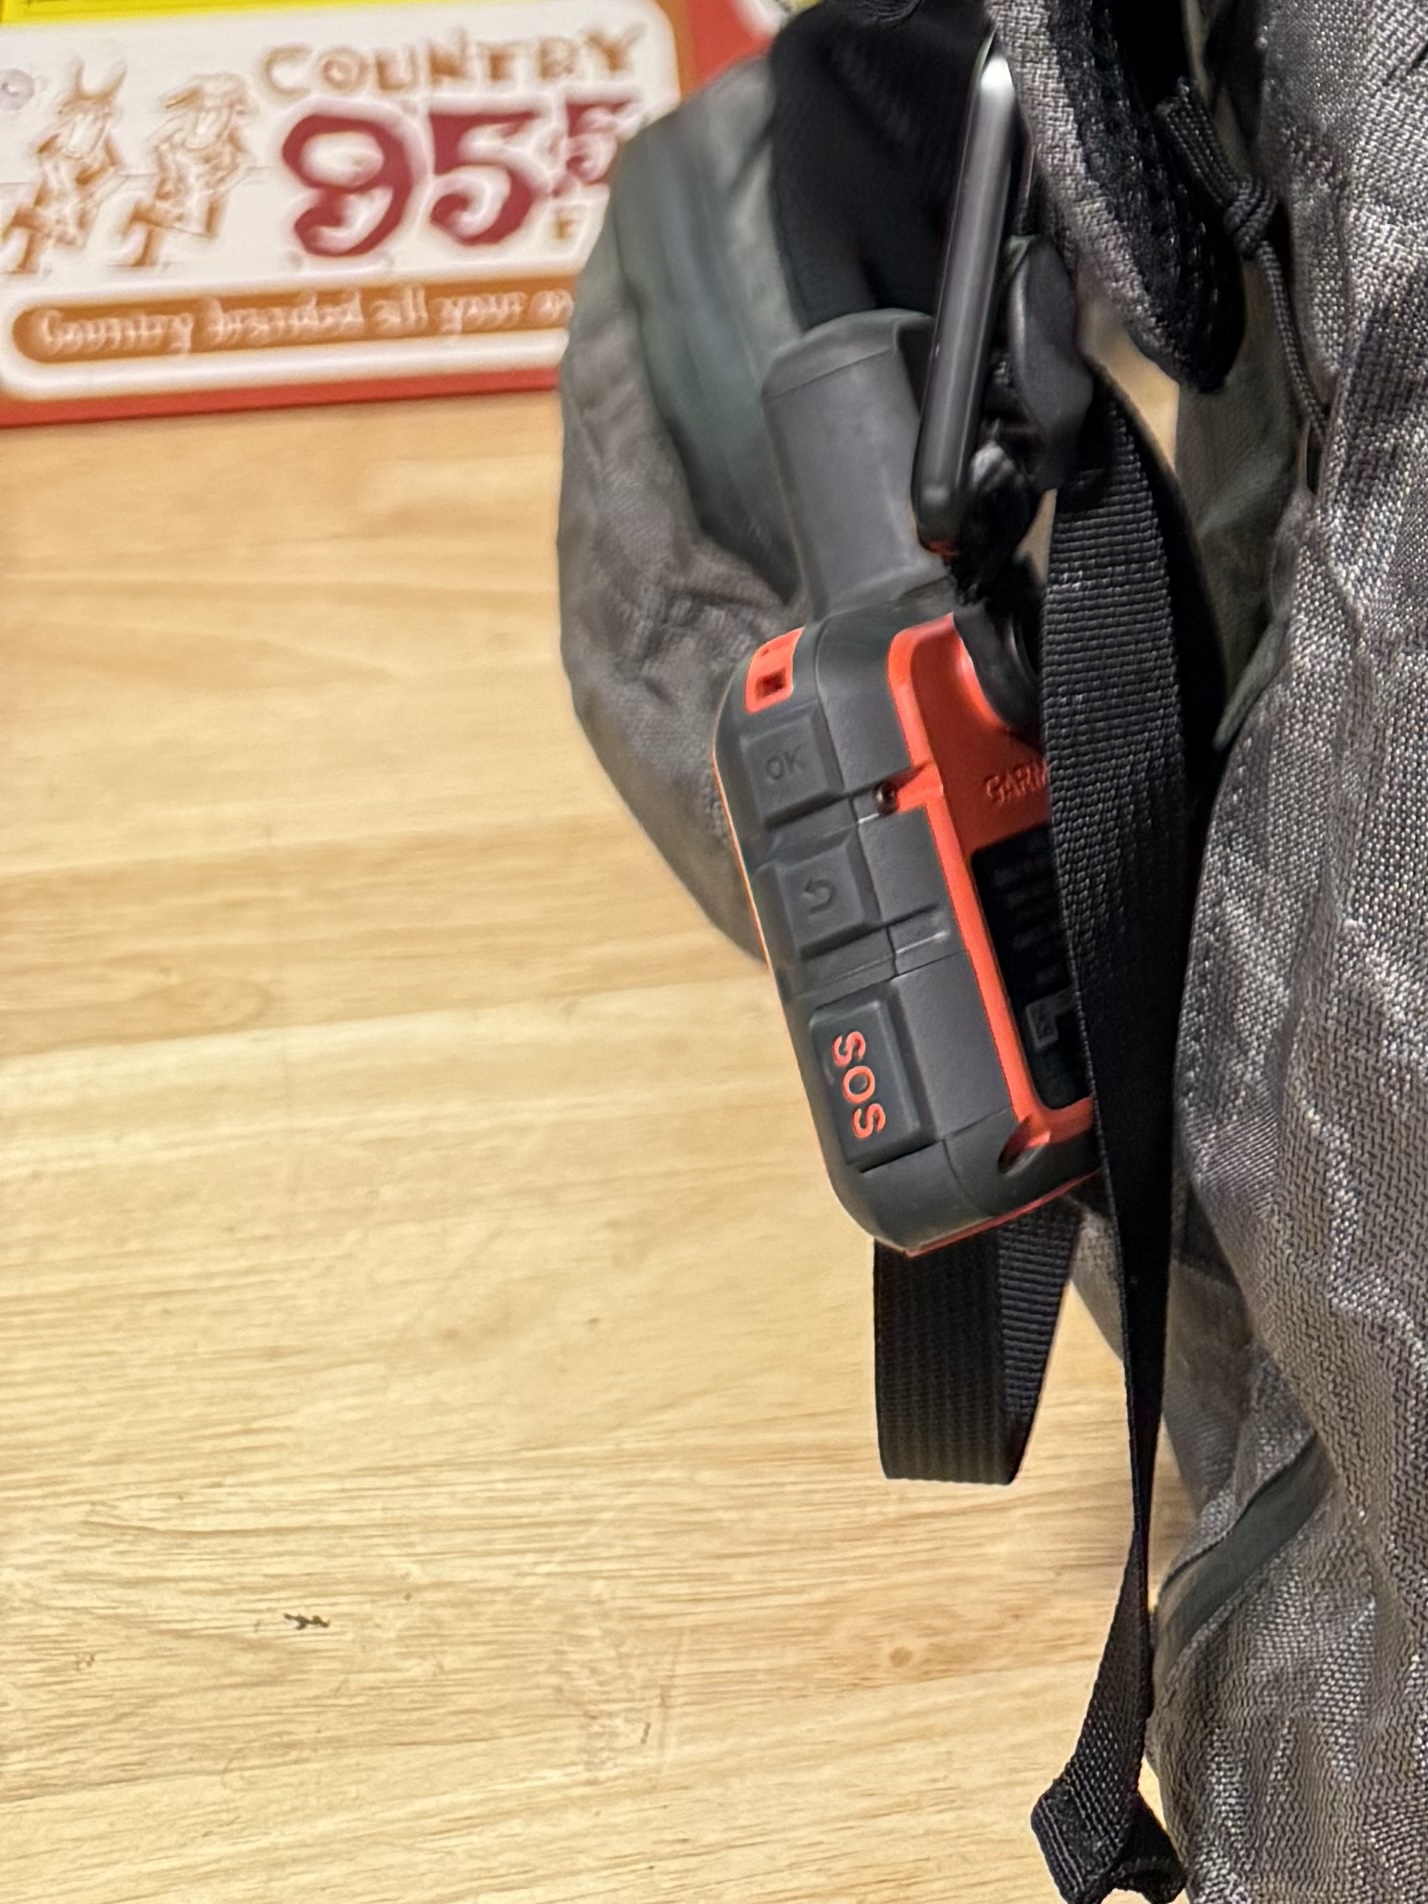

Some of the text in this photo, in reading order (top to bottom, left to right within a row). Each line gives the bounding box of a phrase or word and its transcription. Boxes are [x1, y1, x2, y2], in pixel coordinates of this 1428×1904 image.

[260, 25, 648, 97] COUNTRY
[38, 308, 195, 356] Country
[372, 284, 428, 330] all
[765, 743, 808, 781] OK
[984, 758, 1047, 807] GARM
[831, 1030, 886, 1140] SOS
